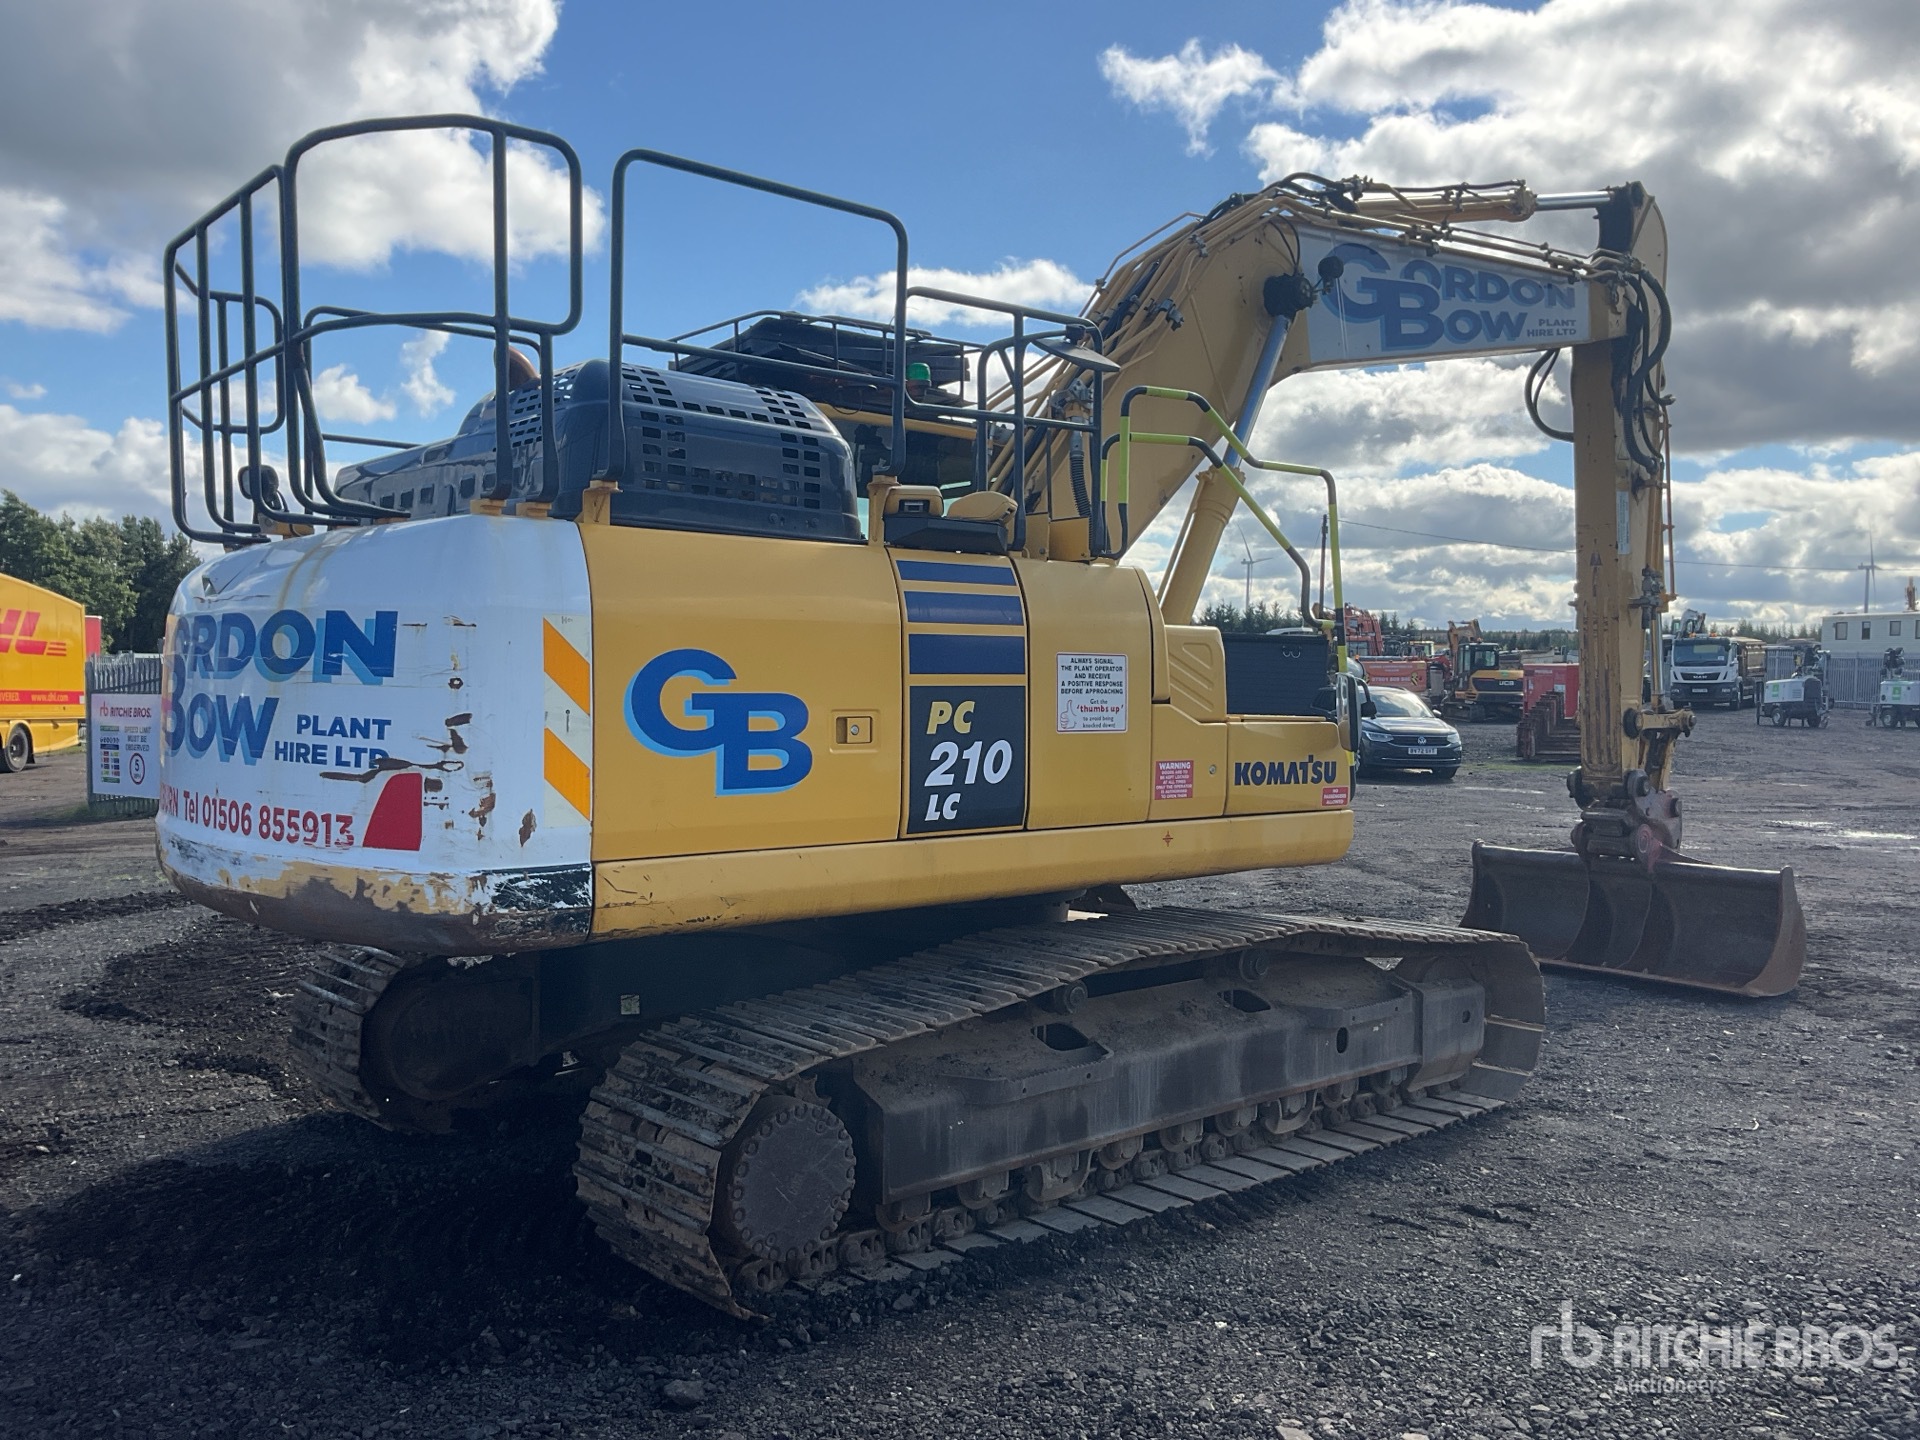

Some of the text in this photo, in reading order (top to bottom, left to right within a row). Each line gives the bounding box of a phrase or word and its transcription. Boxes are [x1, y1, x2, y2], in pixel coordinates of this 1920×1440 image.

[1321, 243, 1576, 323] GORDON
[1381, 277, 1528, 350] BOW
[1538, 319, 1577, 327] PLANT
[1527, 328, 1577, 337] HIRE LTD
[0, 609, 48, 655] HL
[174, 609, 398, 684] ORDON
[110, 706, 133, 717] RITCHIE
[624, 648, 813, 796] GB
[925, 700, 976, 734] PC
[139, 726, 152, 734] LIMIT
[140, 735, 147, 743] BE
[297, 714, 391, 740] PLANT
[125, 744, 150, 752] OBSERVED
[274, 741, 390, 769] HIRE LTD
[134, 759, 140, 772] 5
[923, 739, 1012, 787] 210
[1159, 762, 1191, 770] WARNING
[1234, 755, 1337, 786] KOMATSU
[183, 790, 198, 824] Tel
[202, 795, 252, 836] 01506
[258, 805, 354, 850] 855913
[924, 793, 961, 822] LC
